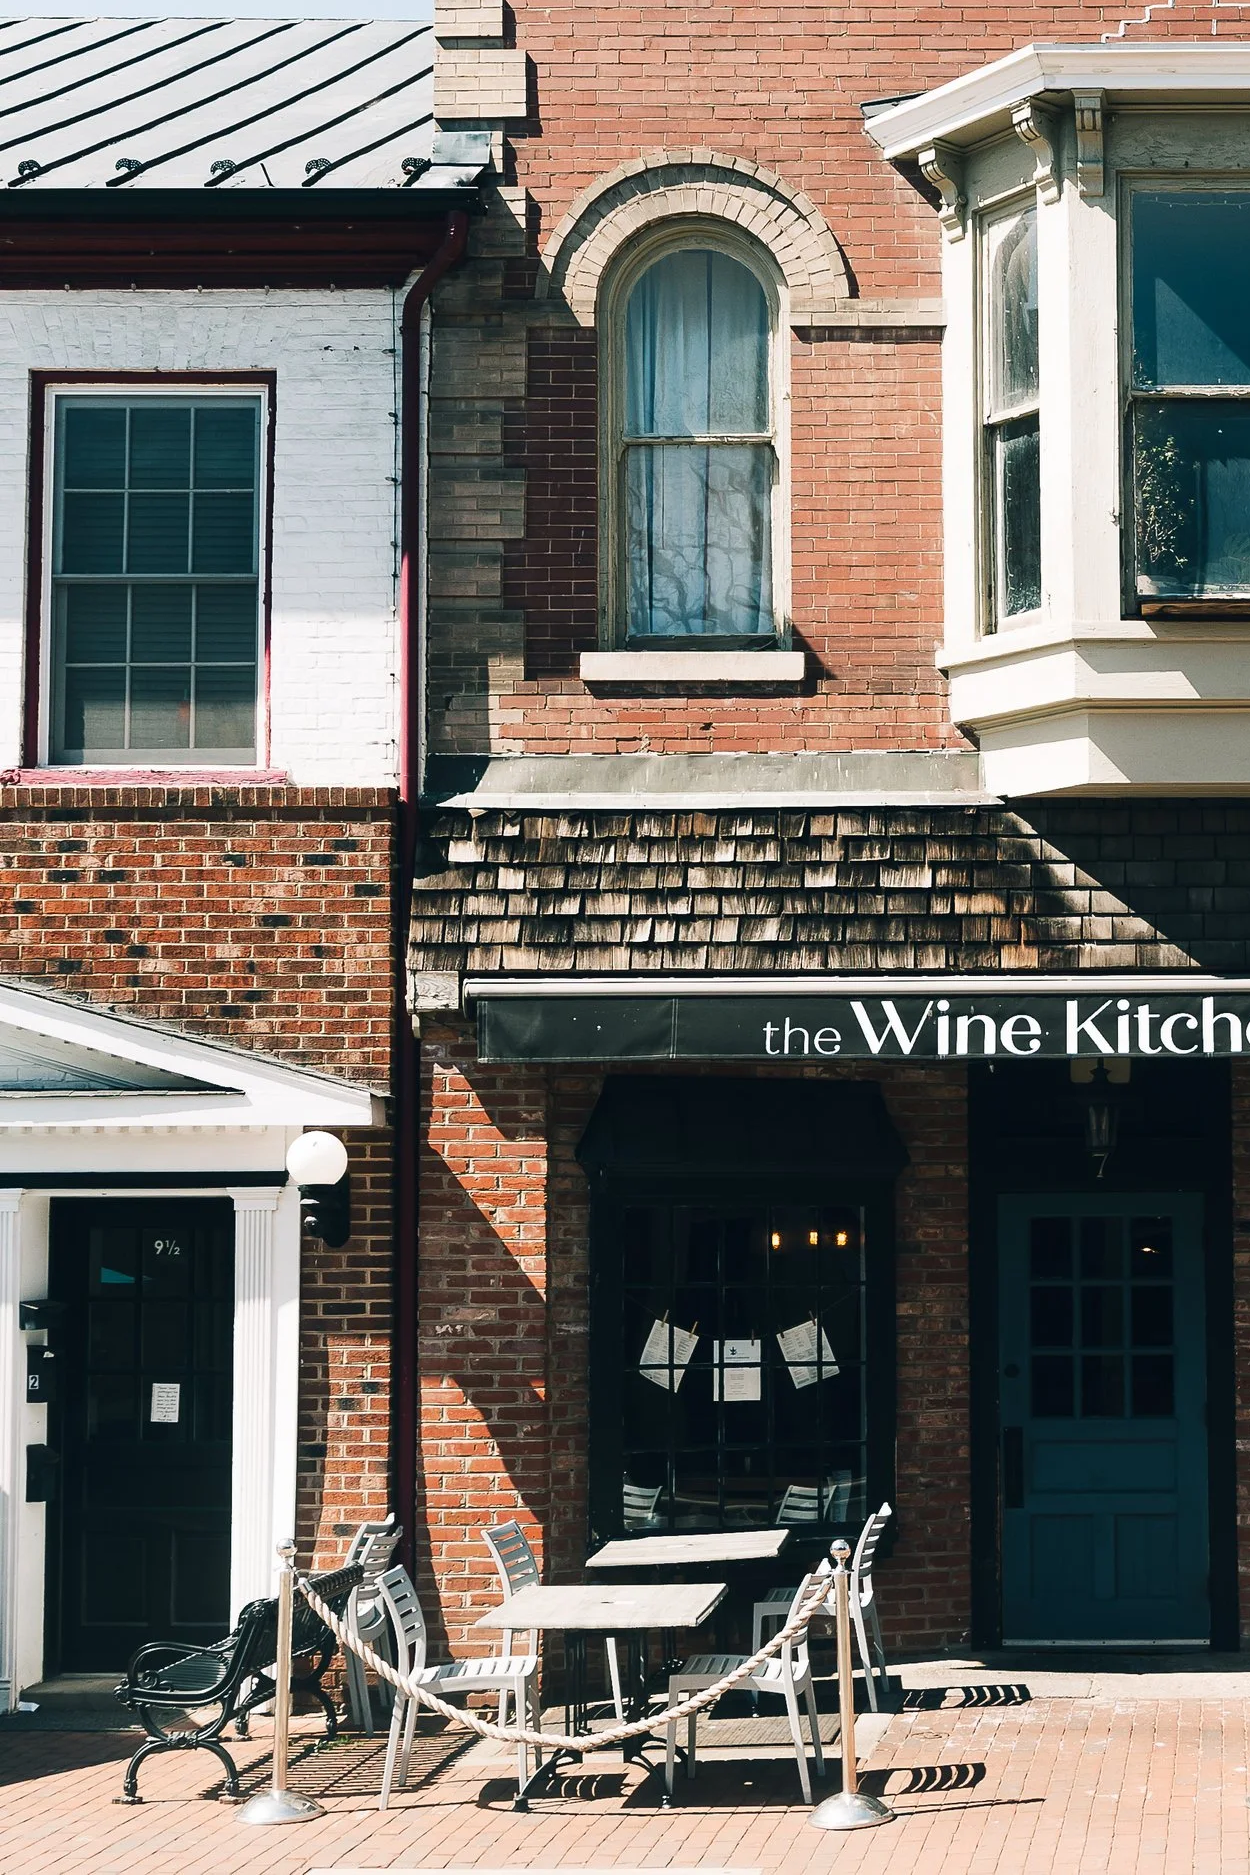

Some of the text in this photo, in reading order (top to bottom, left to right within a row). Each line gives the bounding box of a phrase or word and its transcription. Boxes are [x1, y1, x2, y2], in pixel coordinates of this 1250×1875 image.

[762, 1017, 842, 1056] the
[850, 999, 1042, 1056] Wine
[30, 1376, 38, 1389] 2
